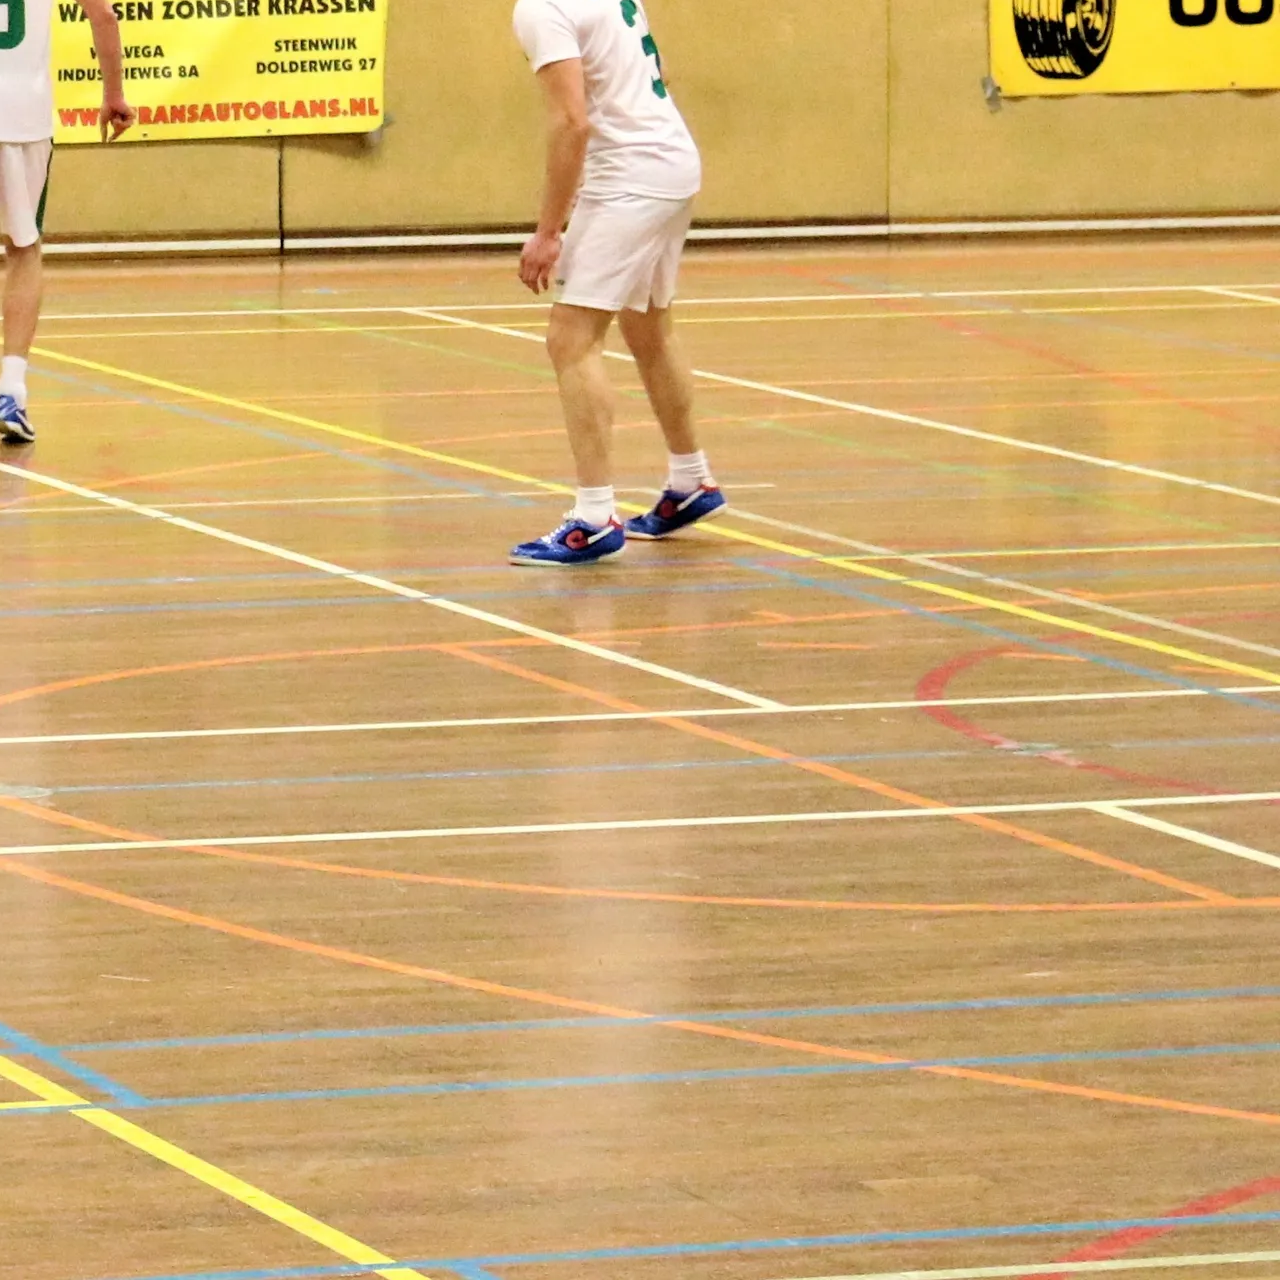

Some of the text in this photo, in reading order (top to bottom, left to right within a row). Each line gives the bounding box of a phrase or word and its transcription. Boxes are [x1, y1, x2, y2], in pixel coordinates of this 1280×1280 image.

[274, 37, 357, 52] STEENWIJK
[58, 65, 200, 82] INDUSIEWEG 8A
[256, 58, 377, 74] DOLDERWEG 27
